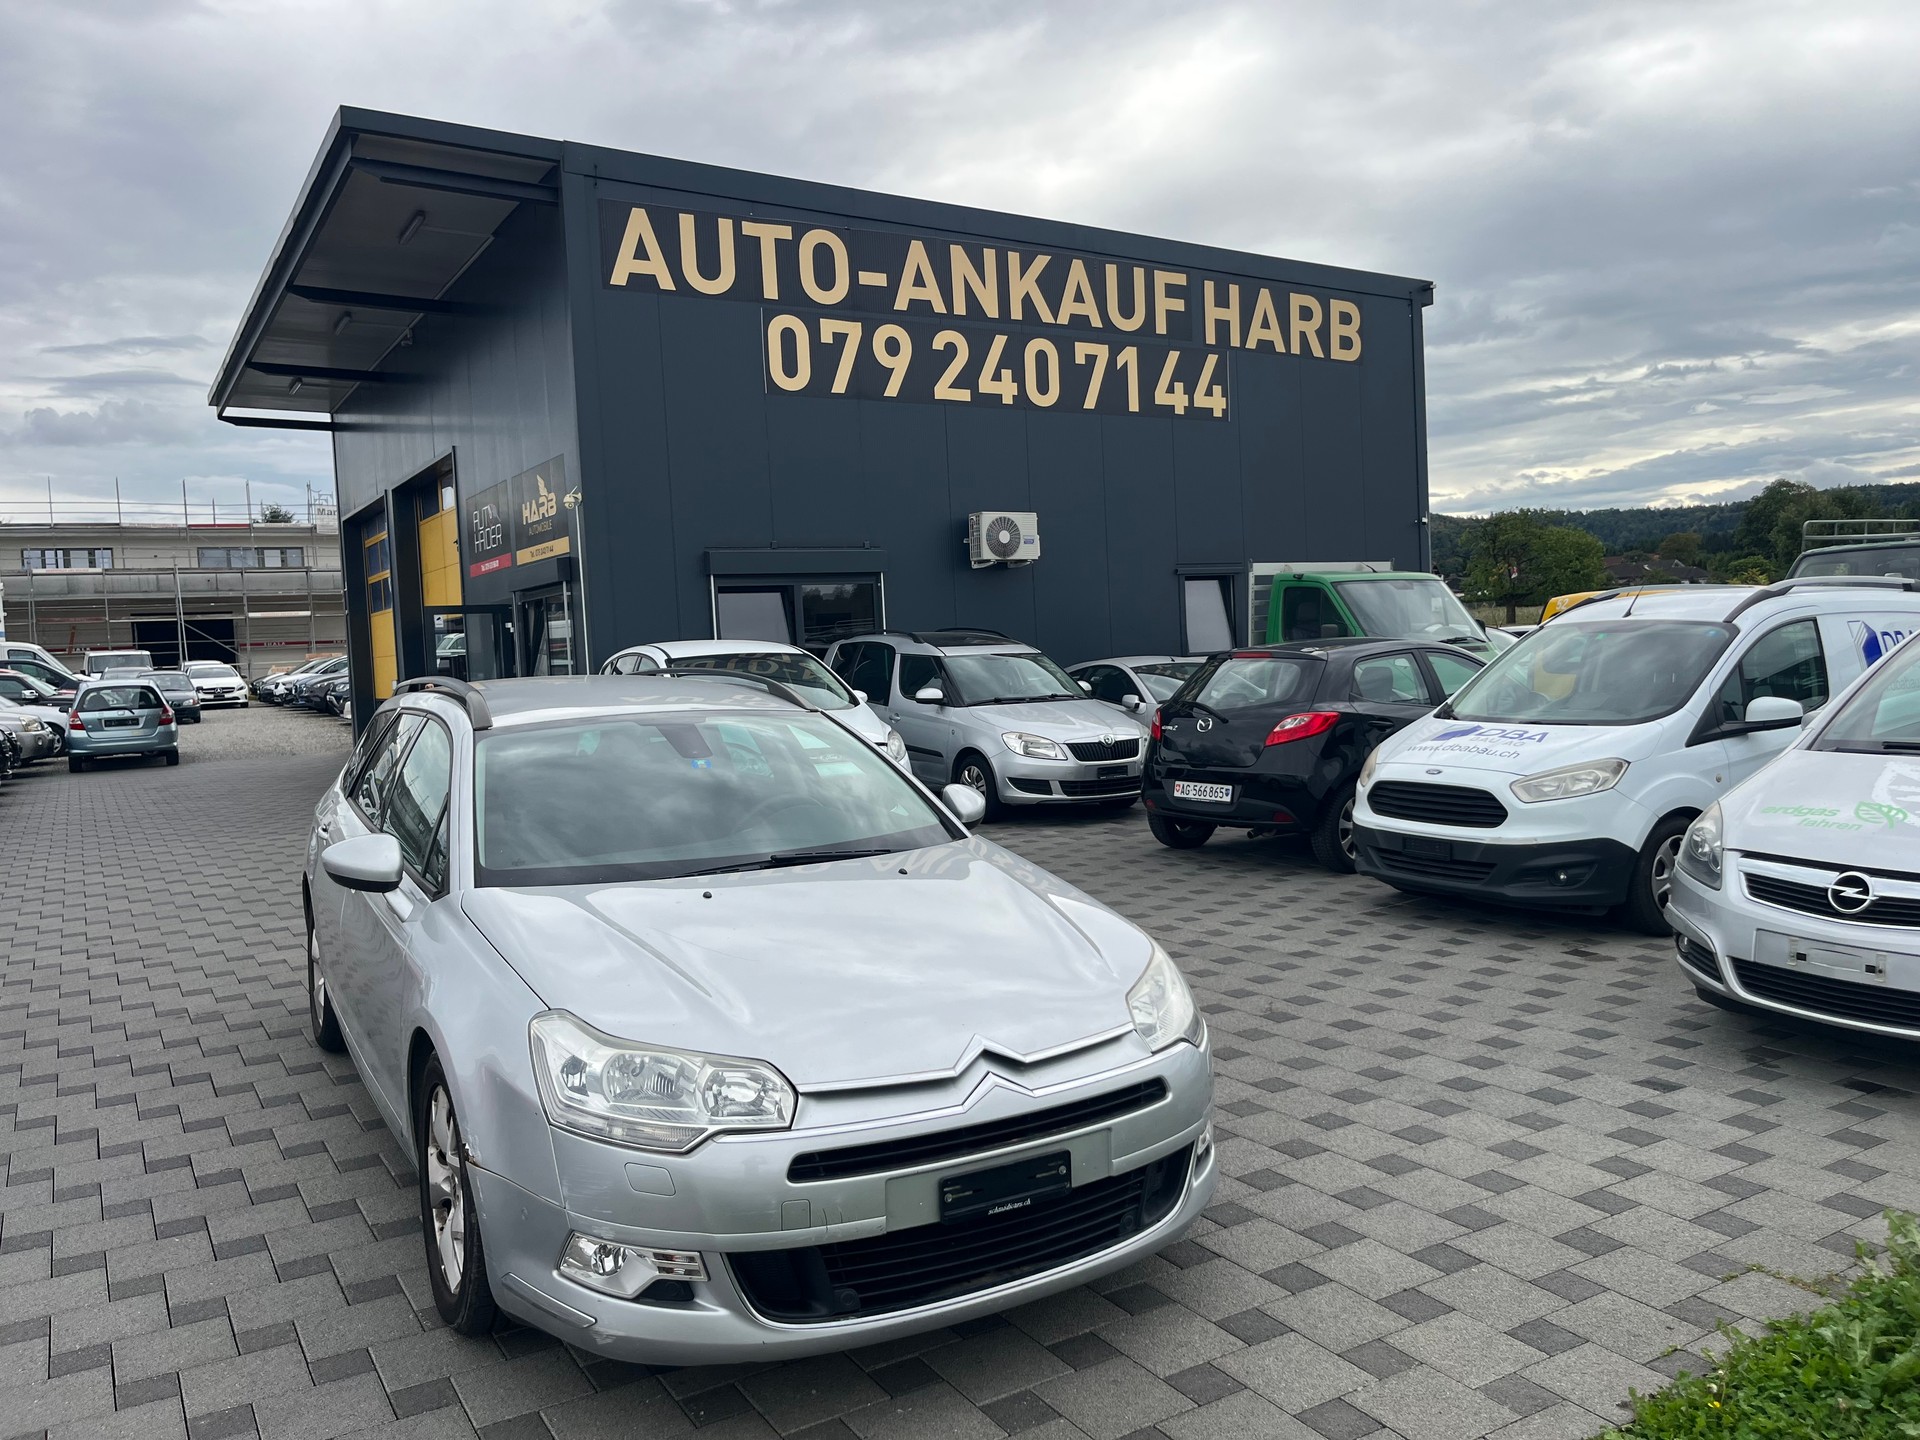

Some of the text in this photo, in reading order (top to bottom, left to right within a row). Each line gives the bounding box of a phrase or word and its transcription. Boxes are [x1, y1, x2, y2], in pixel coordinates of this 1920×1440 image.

[609, 207, 1362, 362] AUTO-ANKAUF HARB
[767, 314, 913, 397] 079
[932, 329, 1060, 408] 240
[522, 492, 557, 525] HARB
[1475, 728, 1549, 743] DBA
[1760, 805, 1840, 817] erdgas
[1798, 817, 1863, 831] fahren
